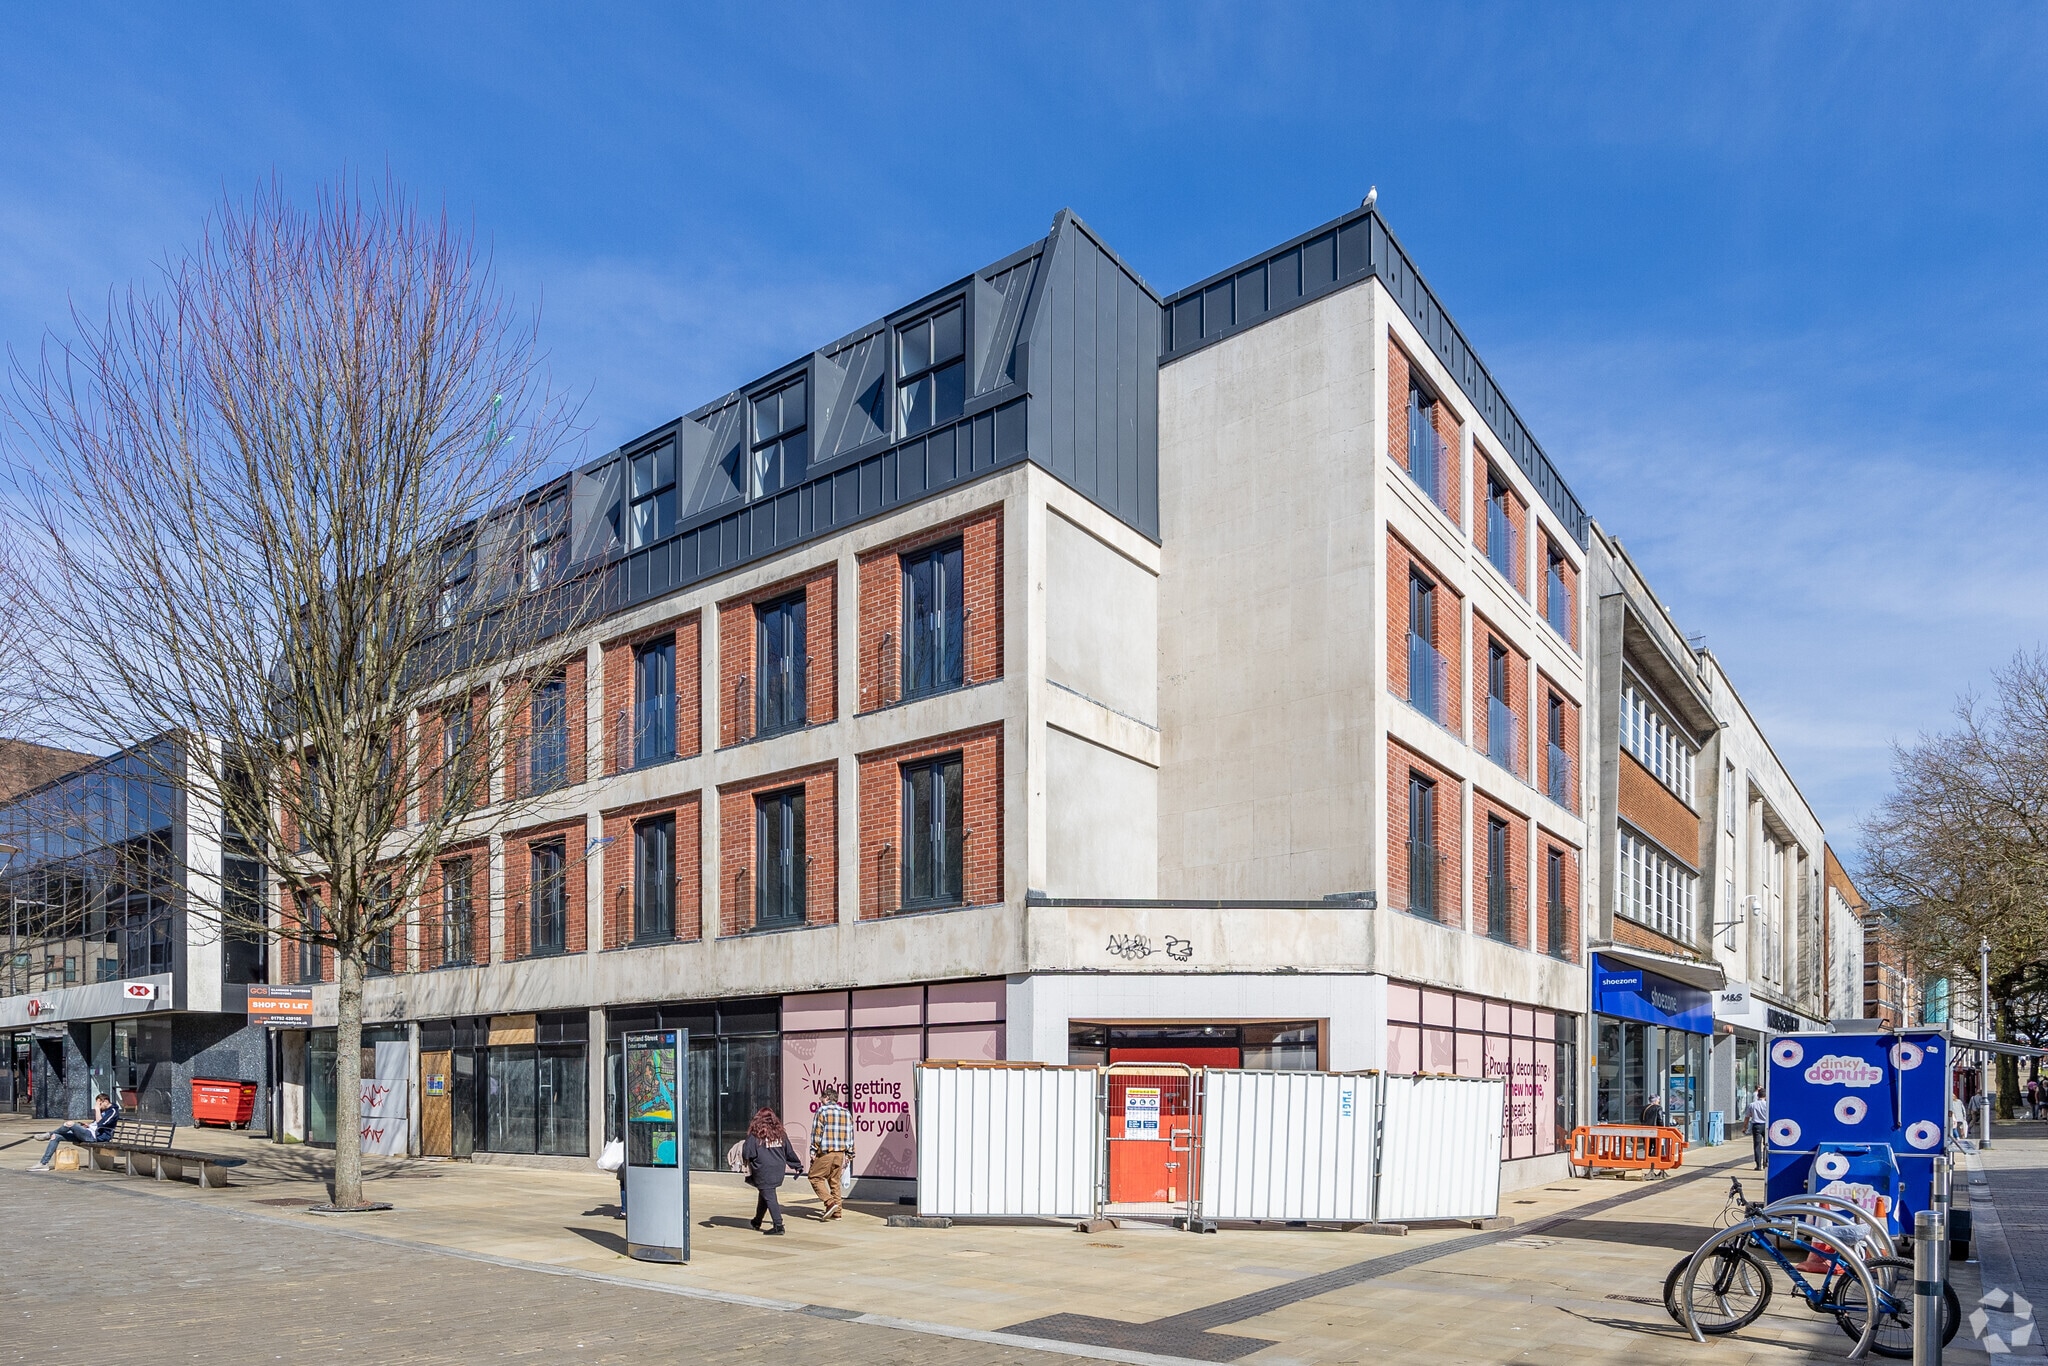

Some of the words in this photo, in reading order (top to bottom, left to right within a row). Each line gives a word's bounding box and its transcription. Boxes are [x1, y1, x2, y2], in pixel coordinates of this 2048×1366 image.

[1602, 977, 1638, 986] shoezone
[1651, 986, 1677, 1012] shoezone
[1721, 993, 1743, 1002] M&S
[292, 1002, 309, 1010] LET
[1489, 1057, 1515, 1080] Proudy
[1516, 1058, 1547, 1081] decorting
[1820, 1058, 1860, 1070] dinky
[1808, 1067, 1879, 1081] donuts
[854, 1078, 901, 1099] getting
[869, 1097, 909, 1113] home
[856, 1116, 875, 1132] for
[1510, 1123, 1537, 1137] wanse
[1829, 1185, 1869, 1199] dinky
